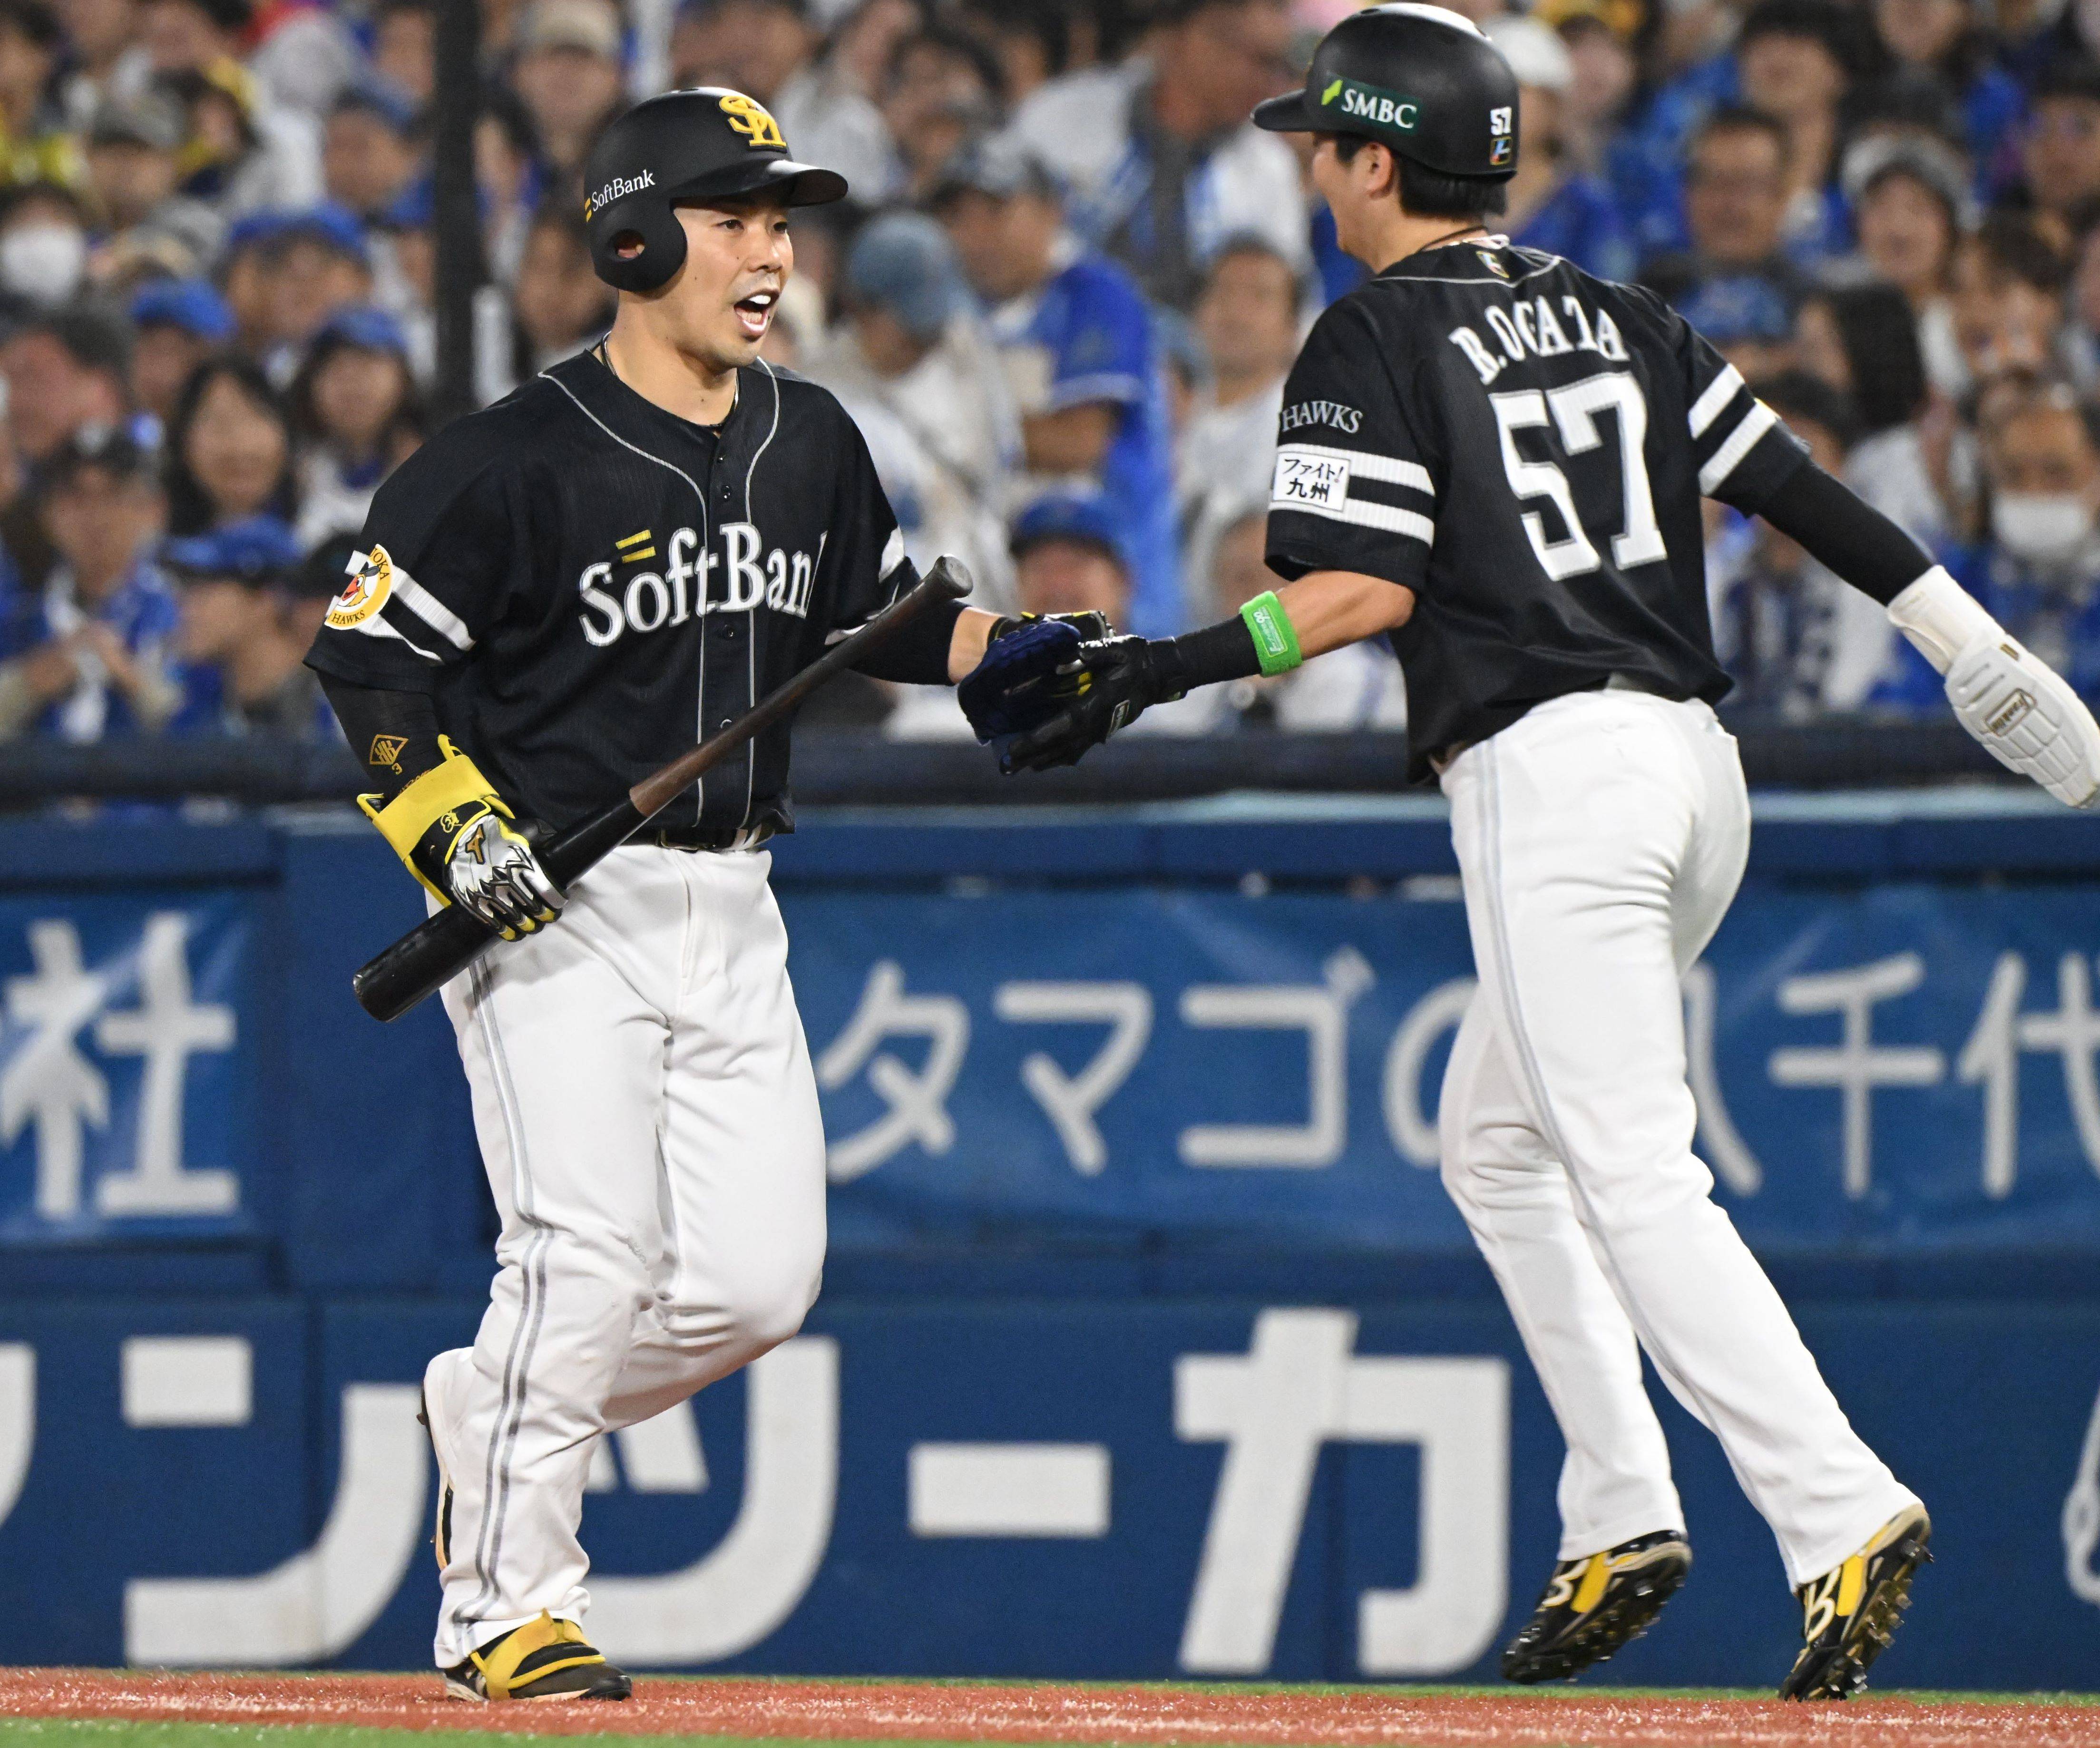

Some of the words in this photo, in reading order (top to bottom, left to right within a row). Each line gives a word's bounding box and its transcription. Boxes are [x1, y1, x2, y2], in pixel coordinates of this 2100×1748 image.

[1340, 88, 1417, 129] SMBC
[1490, 106, 1512, 135] 57
[591, 169, 655, 212] SoftBank
[1282, 400, 1364, 434] HAWKS
[1286, 478, 1330, 503] 九州
[1488, 371, 1668, 582] 57
[578, 521, 828, 647] SoftBan
[331, 609, 366, 625] HAWKS
[391, 762, 403, 775] 3
[0, 909, 240, 1223] 社
